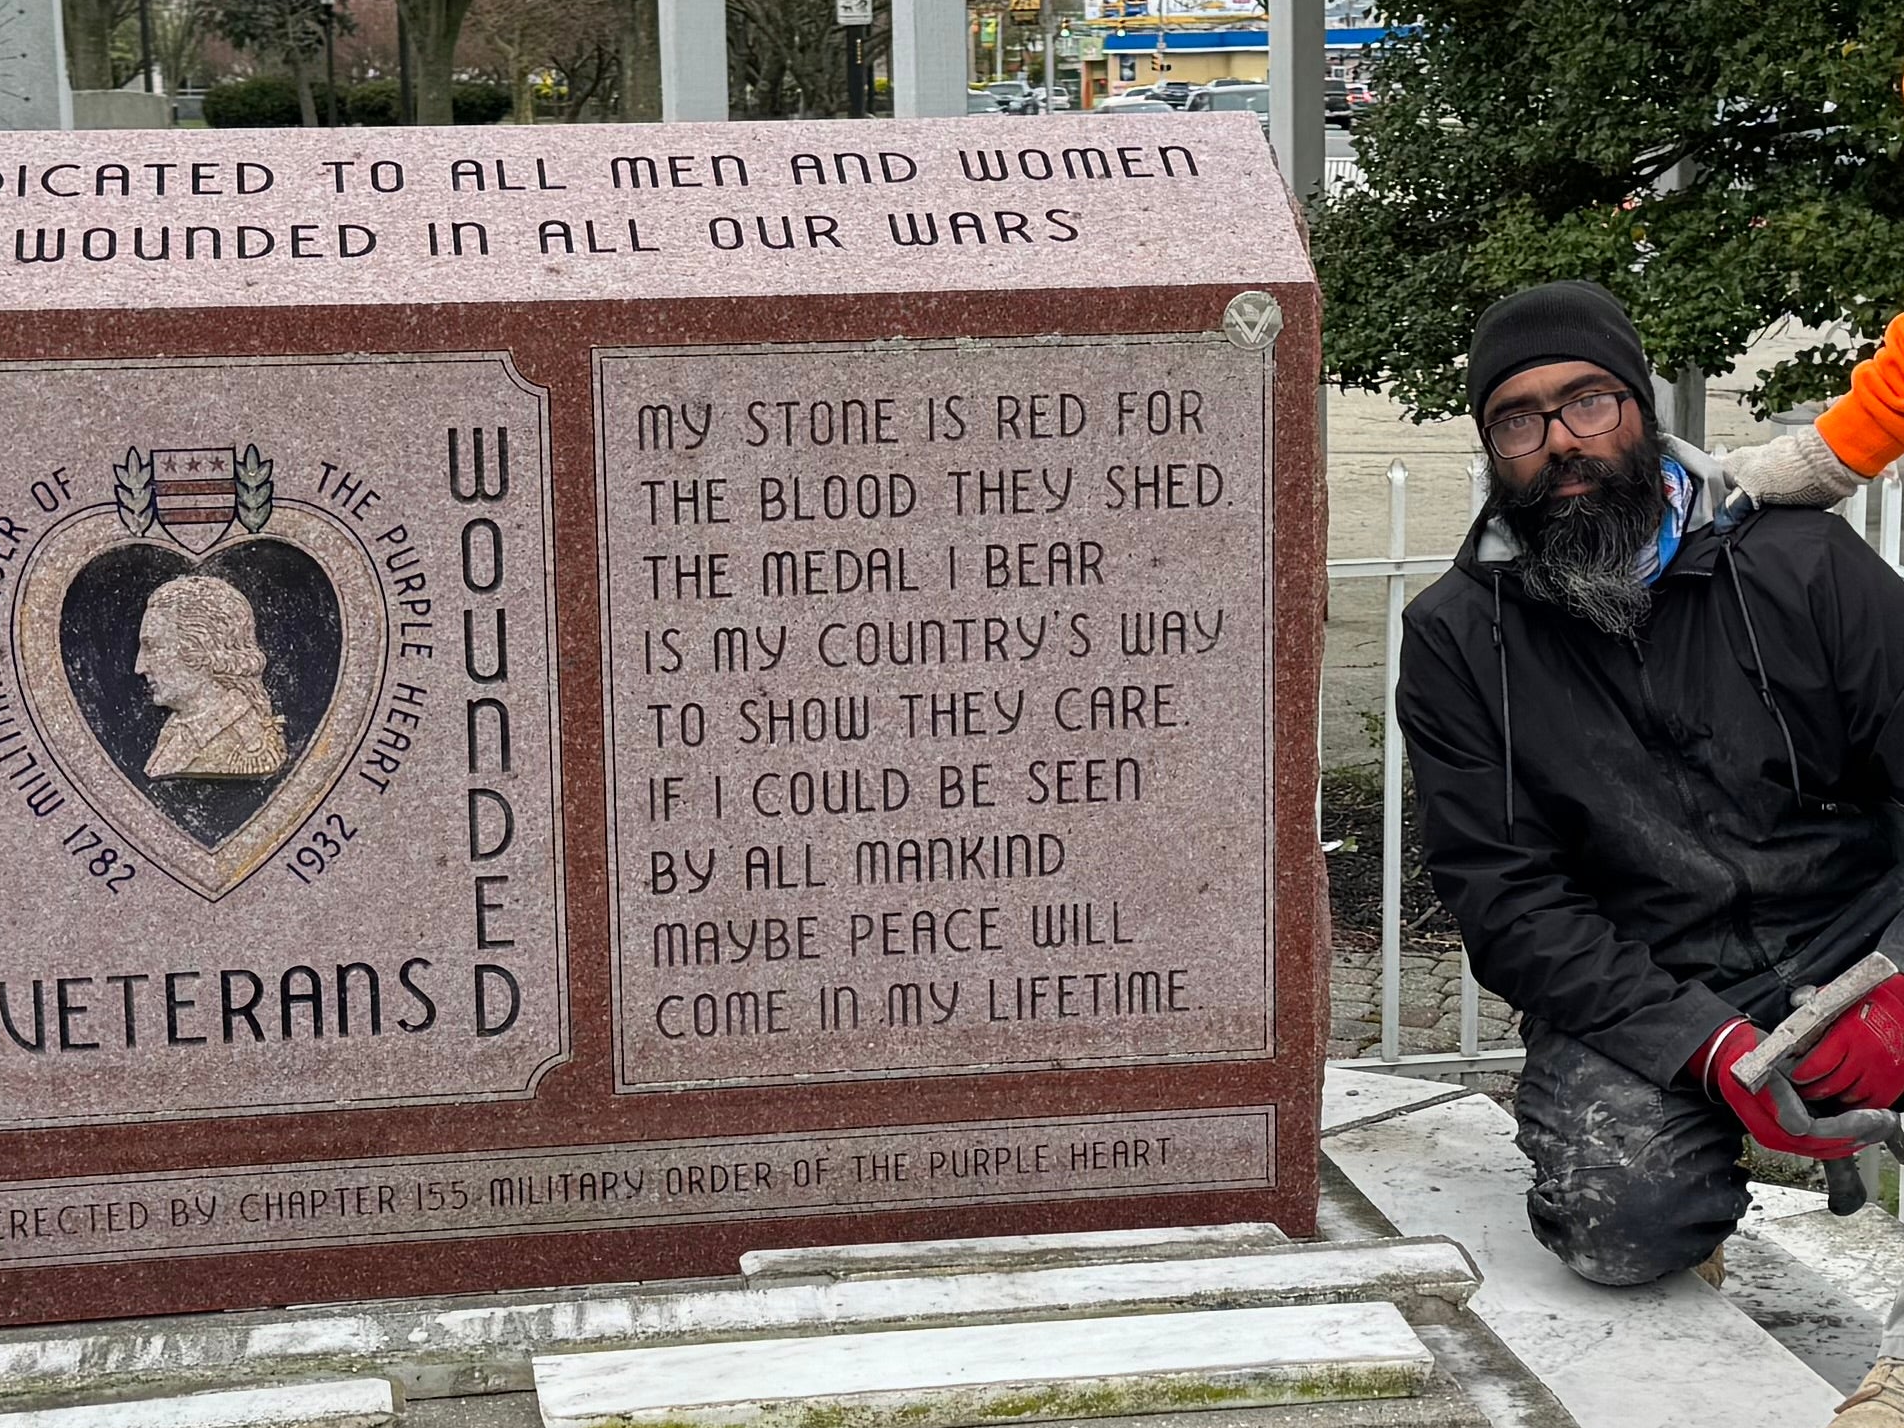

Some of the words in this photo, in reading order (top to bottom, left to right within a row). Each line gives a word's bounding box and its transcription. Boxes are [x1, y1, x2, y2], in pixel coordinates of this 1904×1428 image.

[321, 159, 405, 194] TO
[451, 157, 567, 192] ALL
[610, 154, 750, 190] MEN
[790, 150, 918, 187] AND
[957, 144, 1200, 183] WOMEN
[14, 222, 377, 264] WOUNDED
[427, 220, 490, 257] IN
[538, 217, 660, 254] ALL
[708, 214, 846, 250] OUR
[887, 208, 1081, 246] WARS
[636, 402, 713, 451] MY
[745, 398, 899, 447] STONE
[928, 394, 967, 442] IS
[996, 392, 1086, 440] RED
[1116, 388, 1206, 436] FOR
[30, 466, 72, 512] OF
[317, 461, 382, 521] THE
[642, 478, 732, 526] THE
[759, 471, 917, 522] BLOOD
[946, 466, 1073, 517] THEY
[1105, 463, 1235, 511] SHED.
[375, 523, 433, 659] PURPLE
[643, 553, 732, 600] THE
[762, 547, 920, 596] MEDAL
[948, 545, 957, 591] I
[984, 541, 1106, 590] BEAR
[644, 627, 683, 675] IS
[713, 623, 788, 672] MY
[817, 610, 1093, 668] COUNTRY'S
[1120, 607, 1225, 657] WAY
[359, 682, 428, 795] HEART
[447, 426, 522, 1039] WOUNDED
[647, 702, 706, 748] TO
[738, 695, 870, 744] SHOW
[899, 690, 1026, 739] THEY
[1054, 683, 1191, 733] CARE.
[649, 776, 687, 822] IF
[714, 773, 723, 820] I
[752, 768, 911, 817] COULD
[939, 763, 996, 810] BE
[1025, 757, 1143, 805] SEEN
[63, 823, 136, 895] 1782
[286, 813, 359, 885] 1932
[650, 848, 716, 896] BY
[744, 845, 827, 891] ALL
[855, 832, 1066, 886] MANKIND
[653, 914, 820, 968] MAYBE
[850, 907, 1001, 957] PEACE
[1031, 900, 1134, 949] WILL
[655, 989, 789, 1040] COME
[819, 984, 861, 1030] IN
[887, 979, 960, 1028] MY
[988, 969, 1204, 1021] LIFETIME.
[171, 1196, 217, 1228] BY
[239, 1185, 396, 1223] CHAPTER
[416, 1180, 469, 1212] 155
[489, 1169, 644, 1208] MILITARY
[666, 1161, 773, 1195] ORDER
[793, 1157, 831, 1189] OF
[855, 1152, 907, 1185] THE
[929, 1144, 1051, 1180] PURPLE
[1069, 1137, 1173, 1171] HEART
